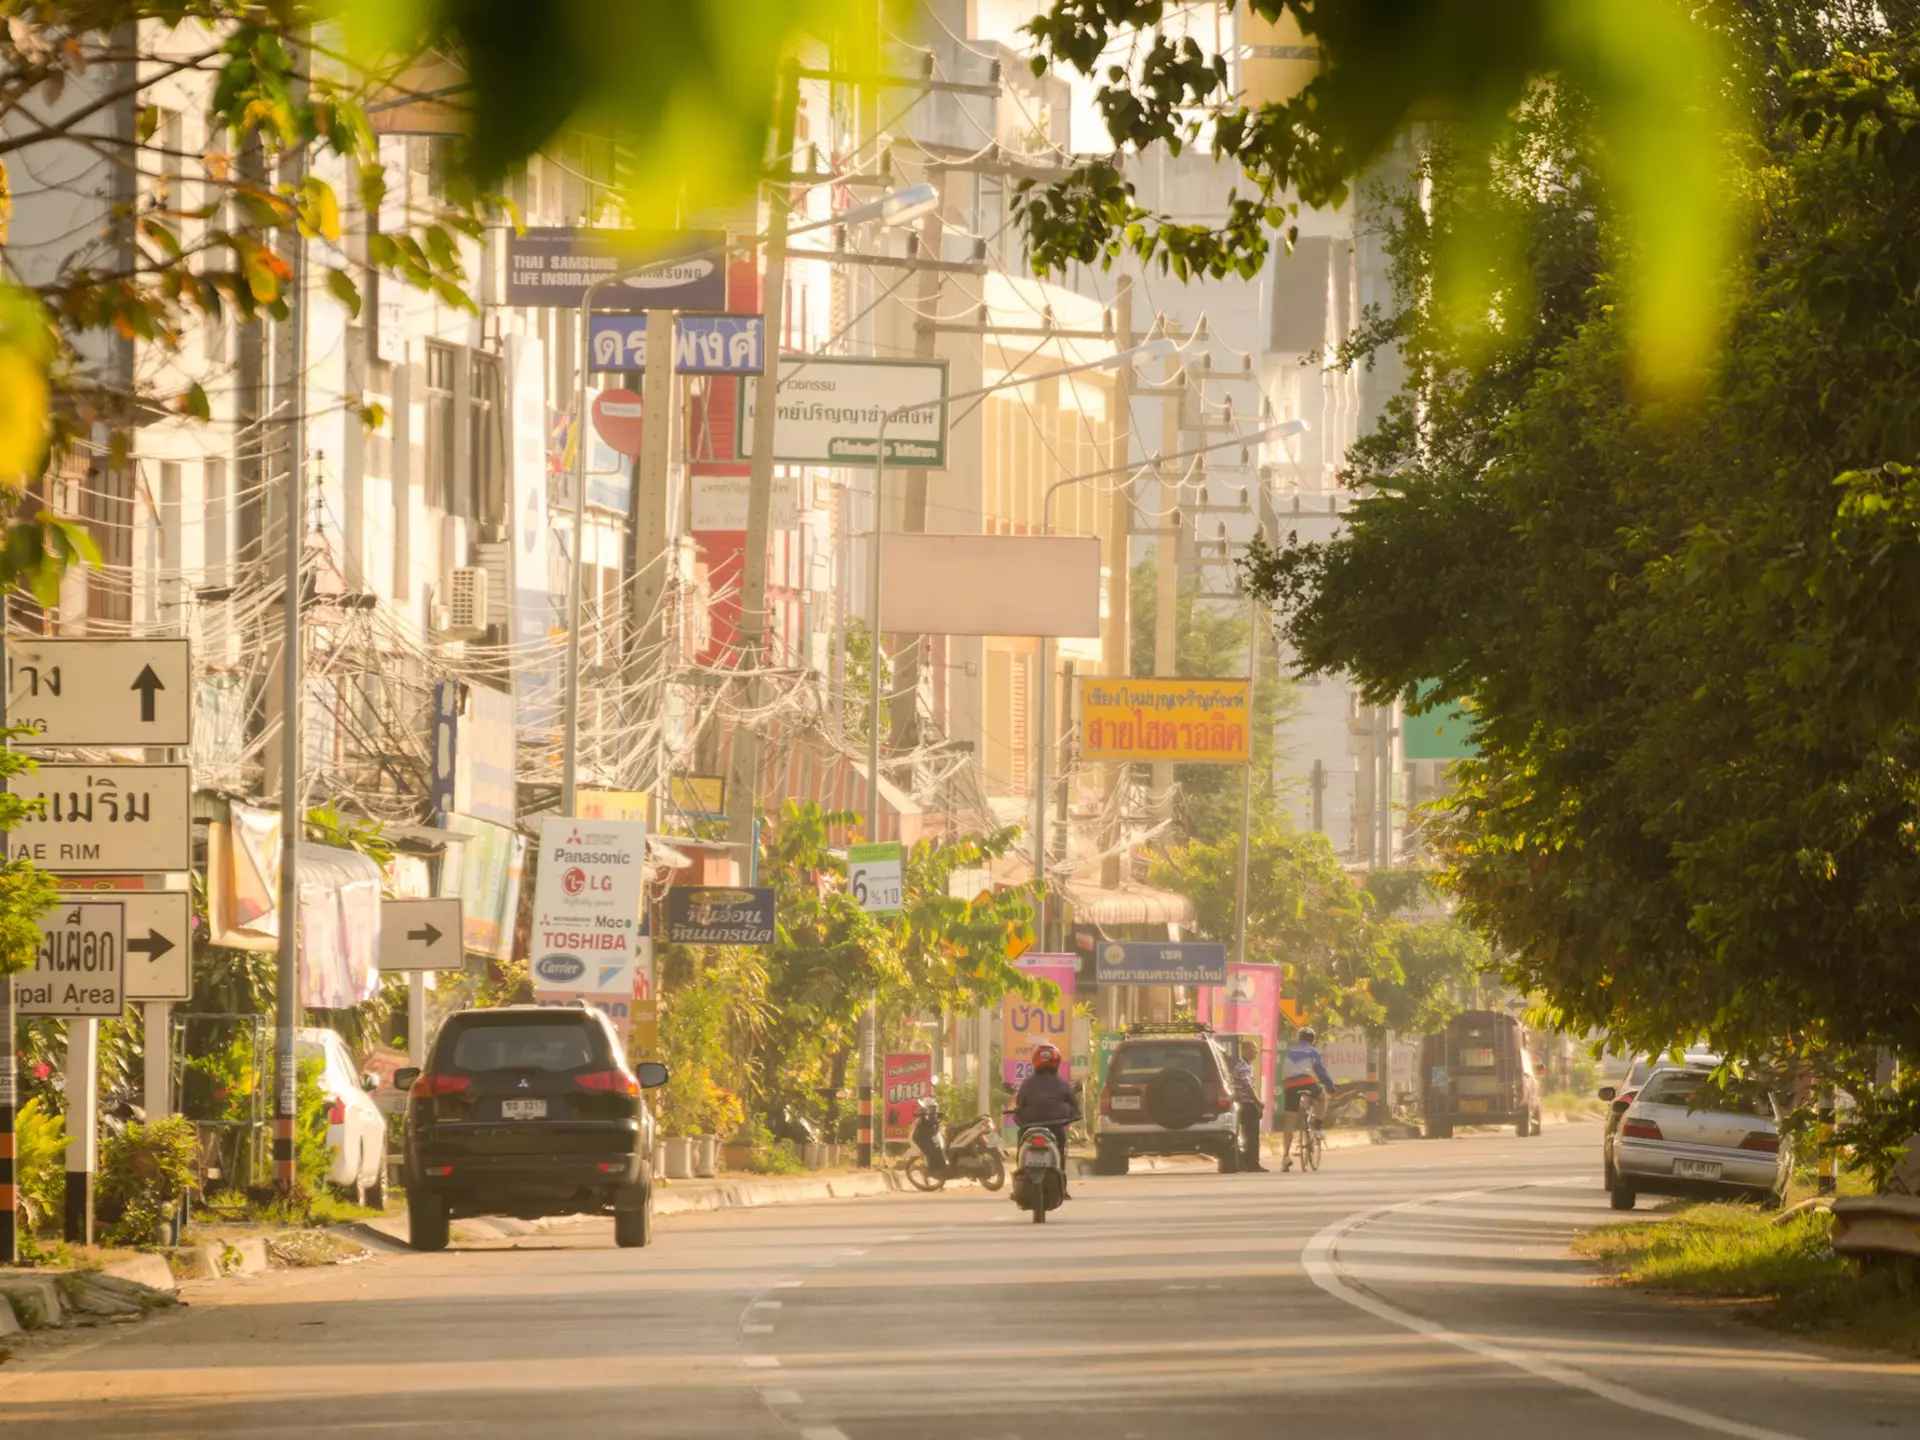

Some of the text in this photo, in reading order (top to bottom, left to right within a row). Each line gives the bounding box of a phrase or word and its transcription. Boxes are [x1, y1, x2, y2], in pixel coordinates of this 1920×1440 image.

[513, 255, 617, 270] THAI SAMSUNG
[513, 272, 539, 285] LIFE
[60, 843, 100, 860] RIM
[554, 847, 631, 865] Panasonic
[590, 874, 613, 892] LG
[543, 932, 628, 951] TOSHIBA
[541, 960, 579, 974] Carrier
[63, 983, 115, 1005] Area
